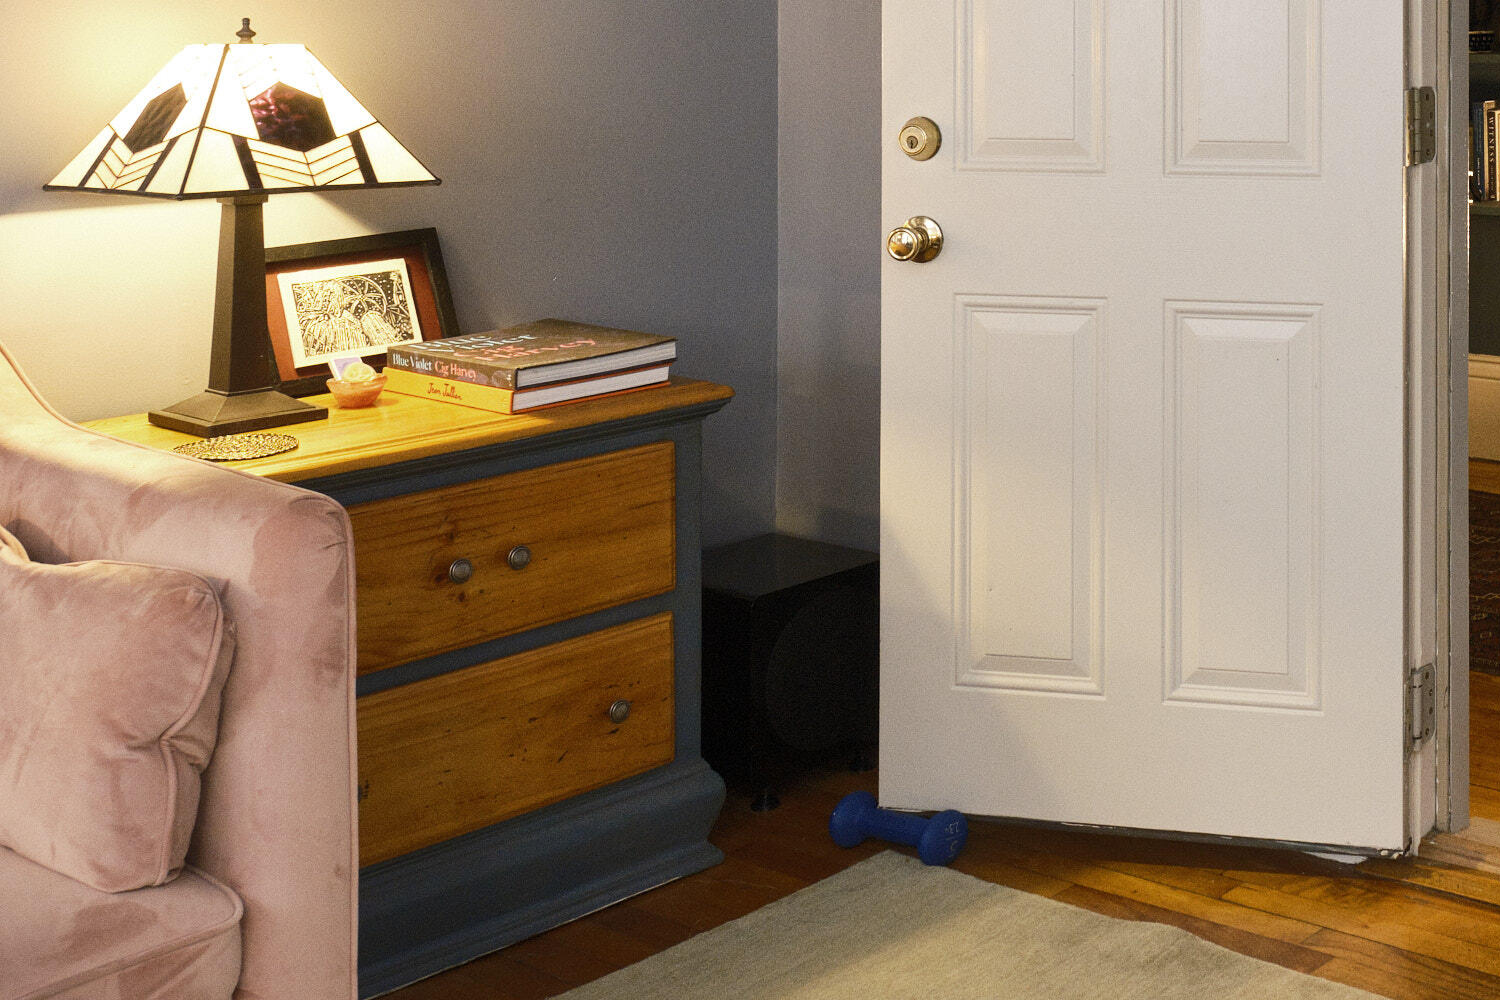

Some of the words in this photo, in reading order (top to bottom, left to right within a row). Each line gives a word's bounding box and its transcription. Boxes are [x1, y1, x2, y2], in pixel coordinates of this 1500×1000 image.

[392, 353, 410, 368] Blue
[410, 355, 433, 372] Violet
[450, 364, 477, 380] Harvey
